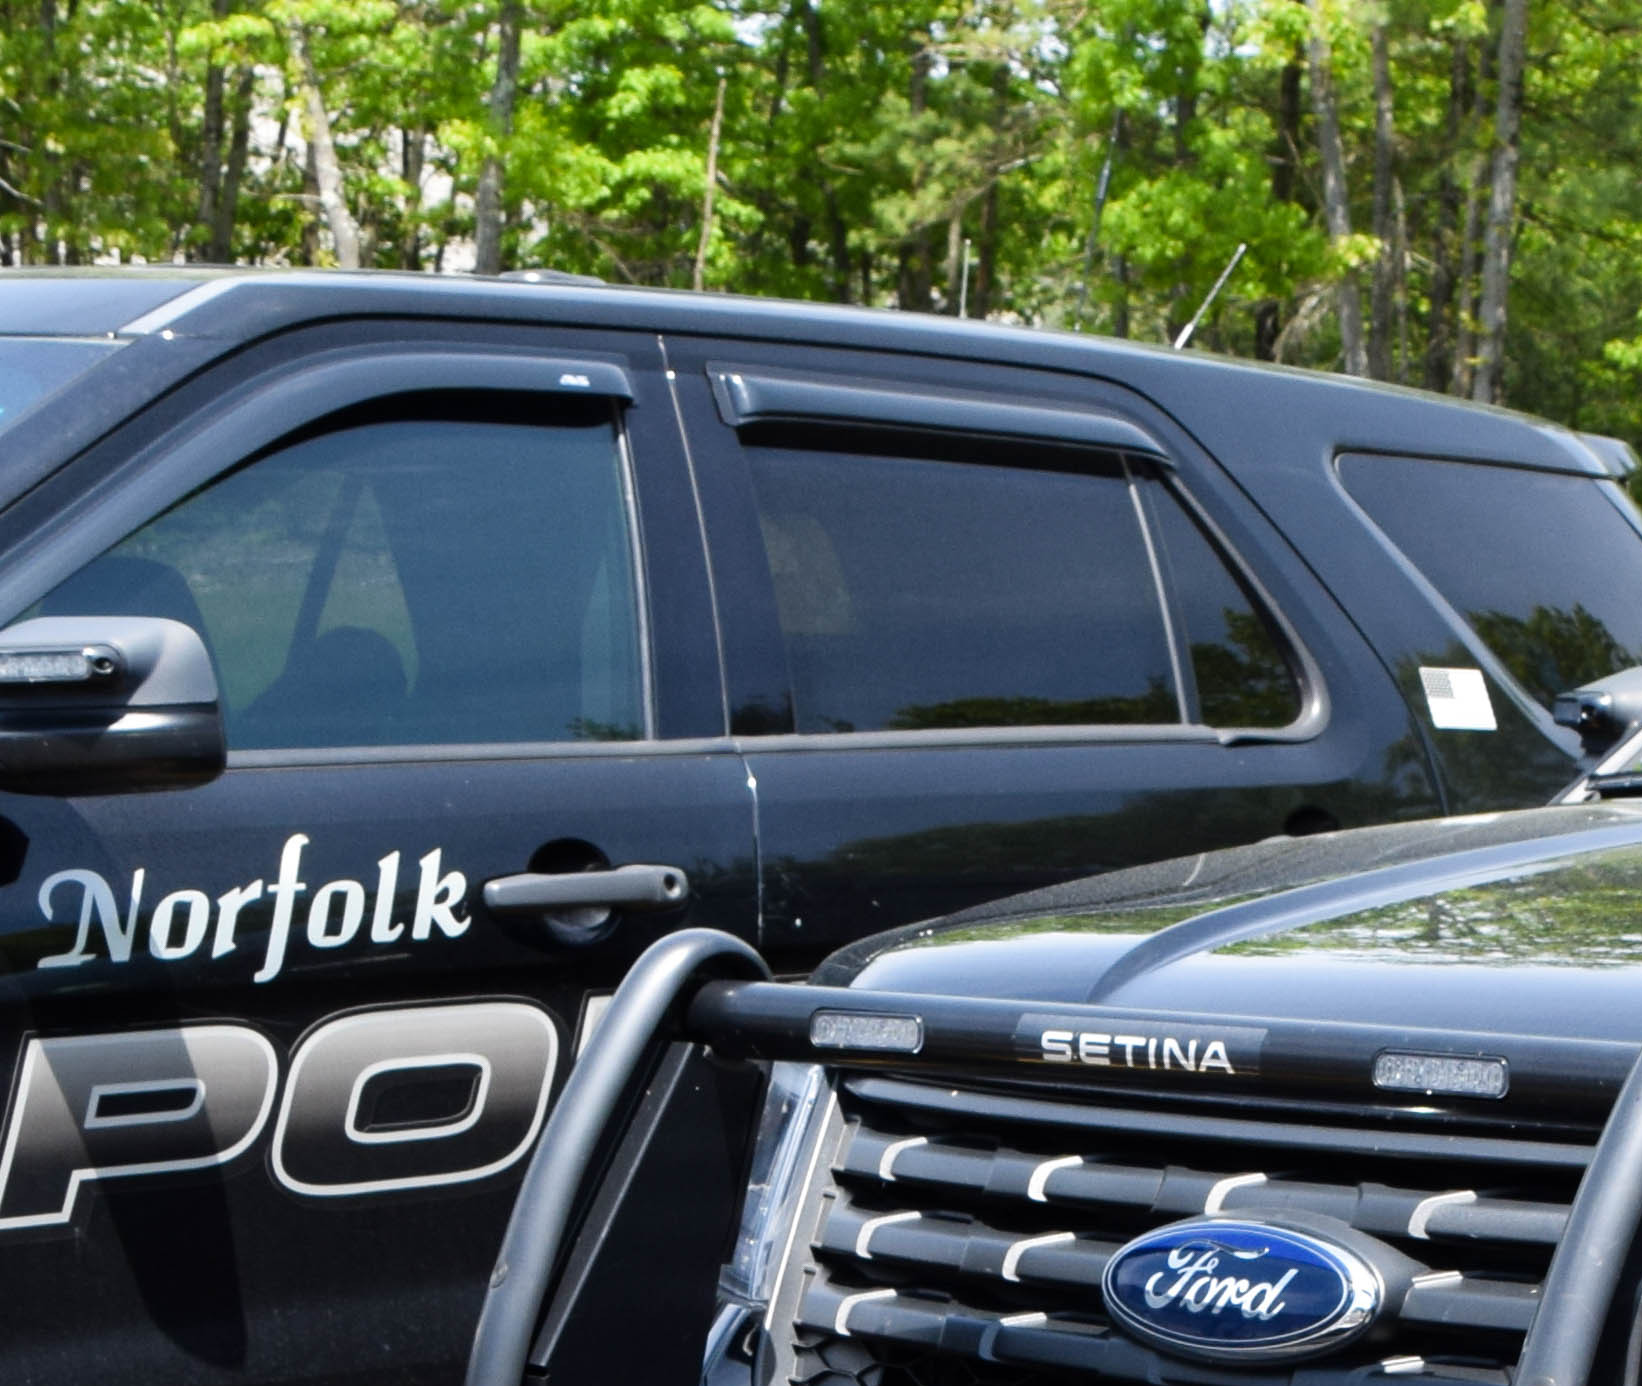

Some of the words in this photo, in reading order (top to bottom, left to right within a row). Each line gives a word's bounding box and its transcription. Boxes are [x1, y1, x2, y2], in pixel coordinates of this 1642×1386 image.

[38, 833, 472, 983] Norfolk
[1041, 1030, 1235, 1074] SETINA
[1145, 1239, 1299, 1320] Ford
